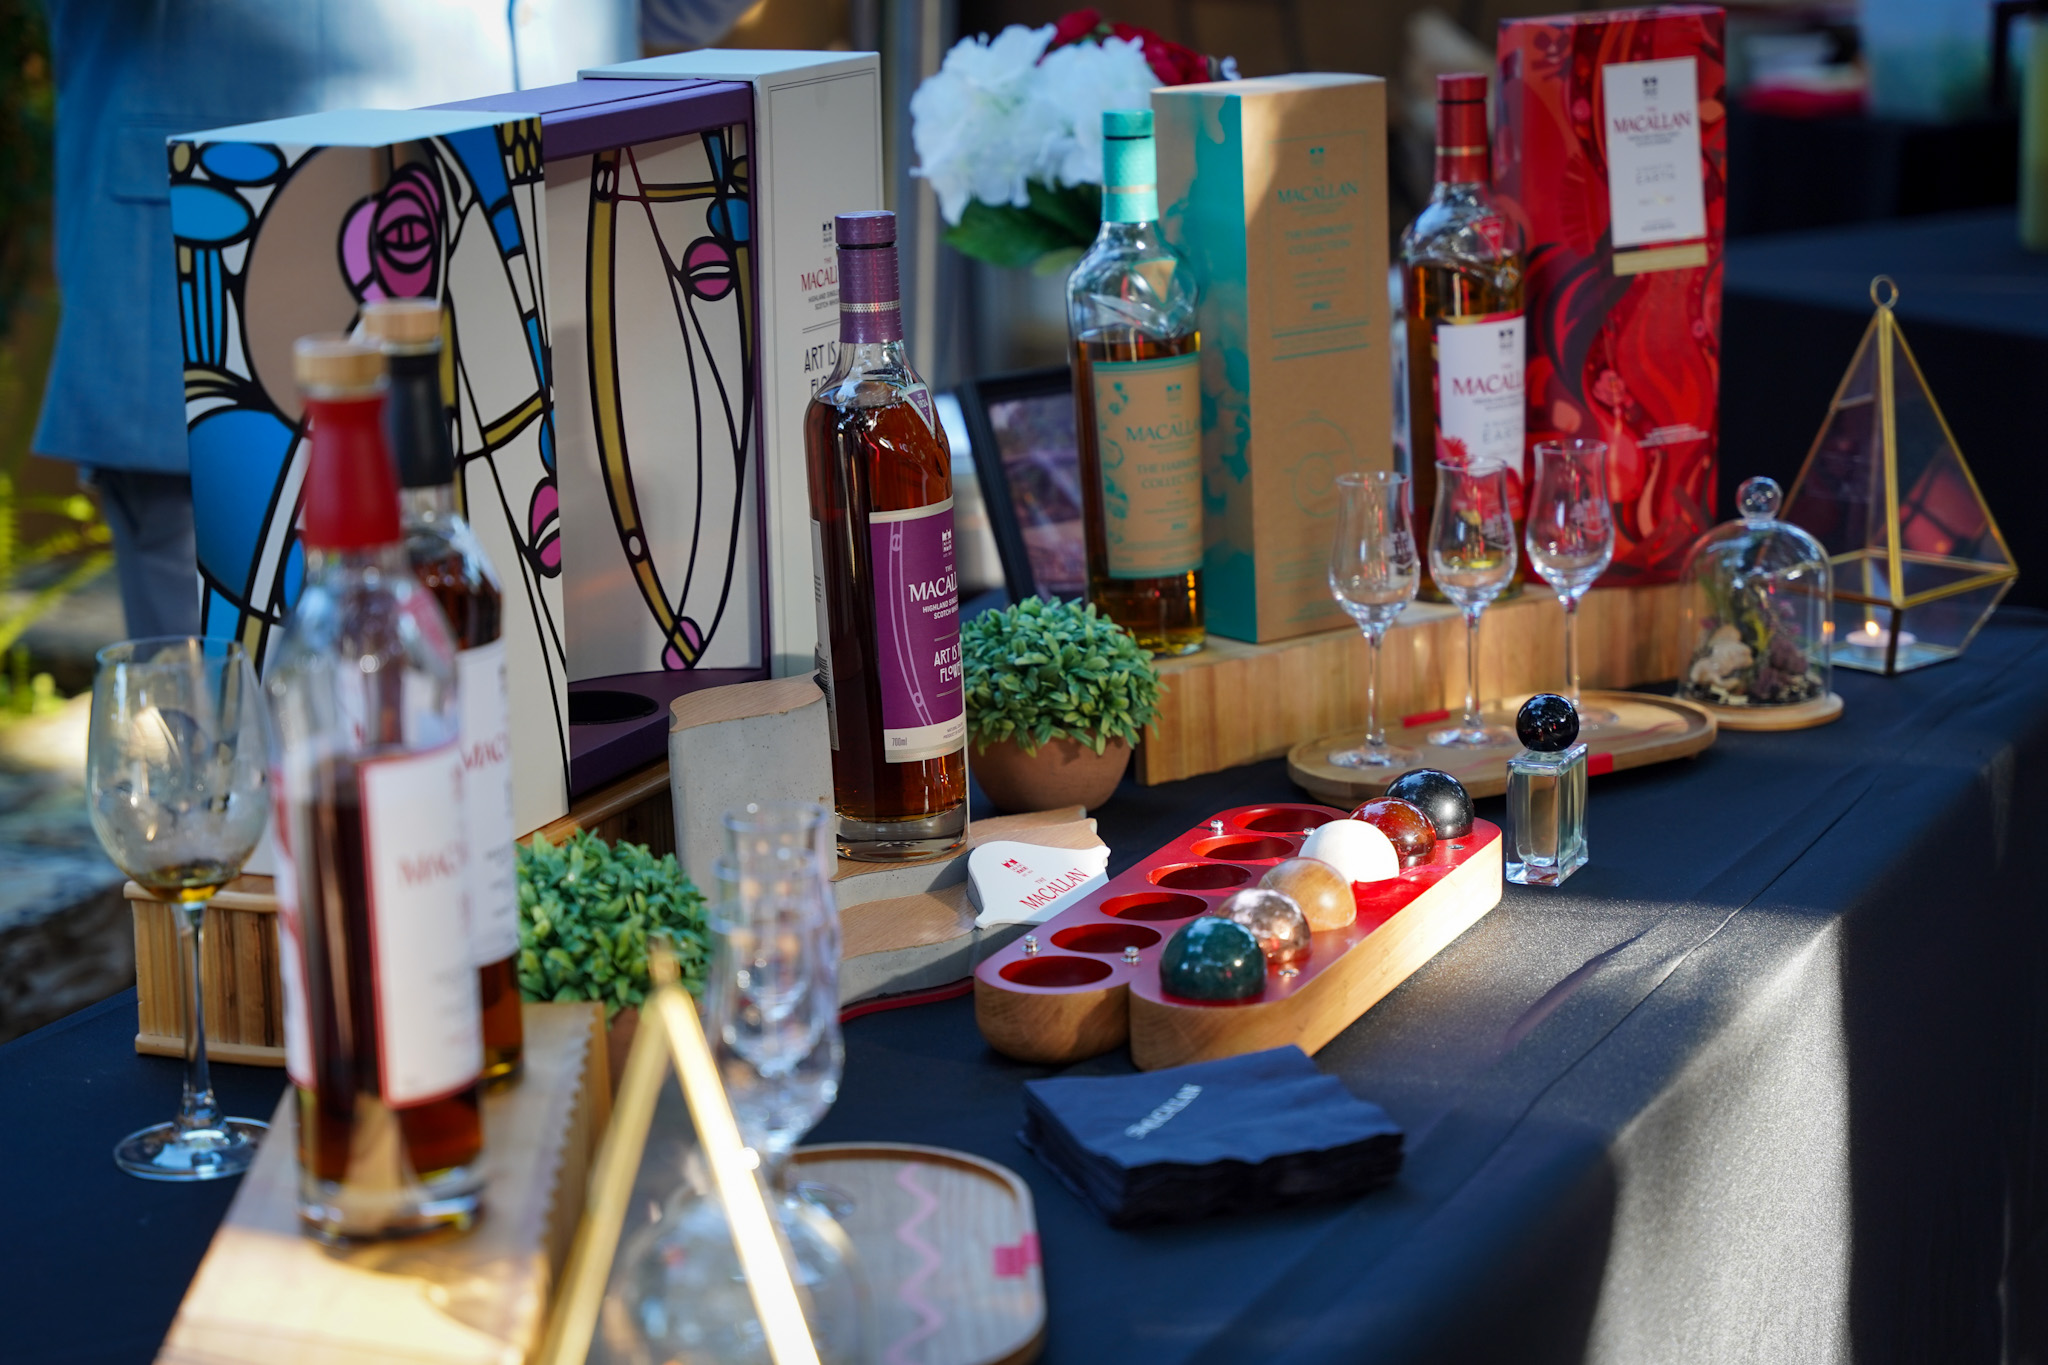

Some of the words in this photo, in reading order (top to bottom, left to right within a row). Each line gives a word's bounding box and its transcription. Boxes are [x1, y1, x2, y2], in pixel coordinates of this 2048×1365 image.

[1613, 110, 1692, 133] MACALLAN
[1276, 181, 1359, 204] MACALLAN
[804, 344, 824, 373] ART
[828, 341, 837, 366] IS
[908, 571, 958, 603] MACALL
[922, 600, 949, 614] HIGHLAND
[933, 608, 951, 620] SCOTCH
[933, 647, 951, 667] ART
[952, 644, 958, 661] IS
[891, 737, 908, 747] 700ml
[1018, 868, 1090, 911] MACALLAN
